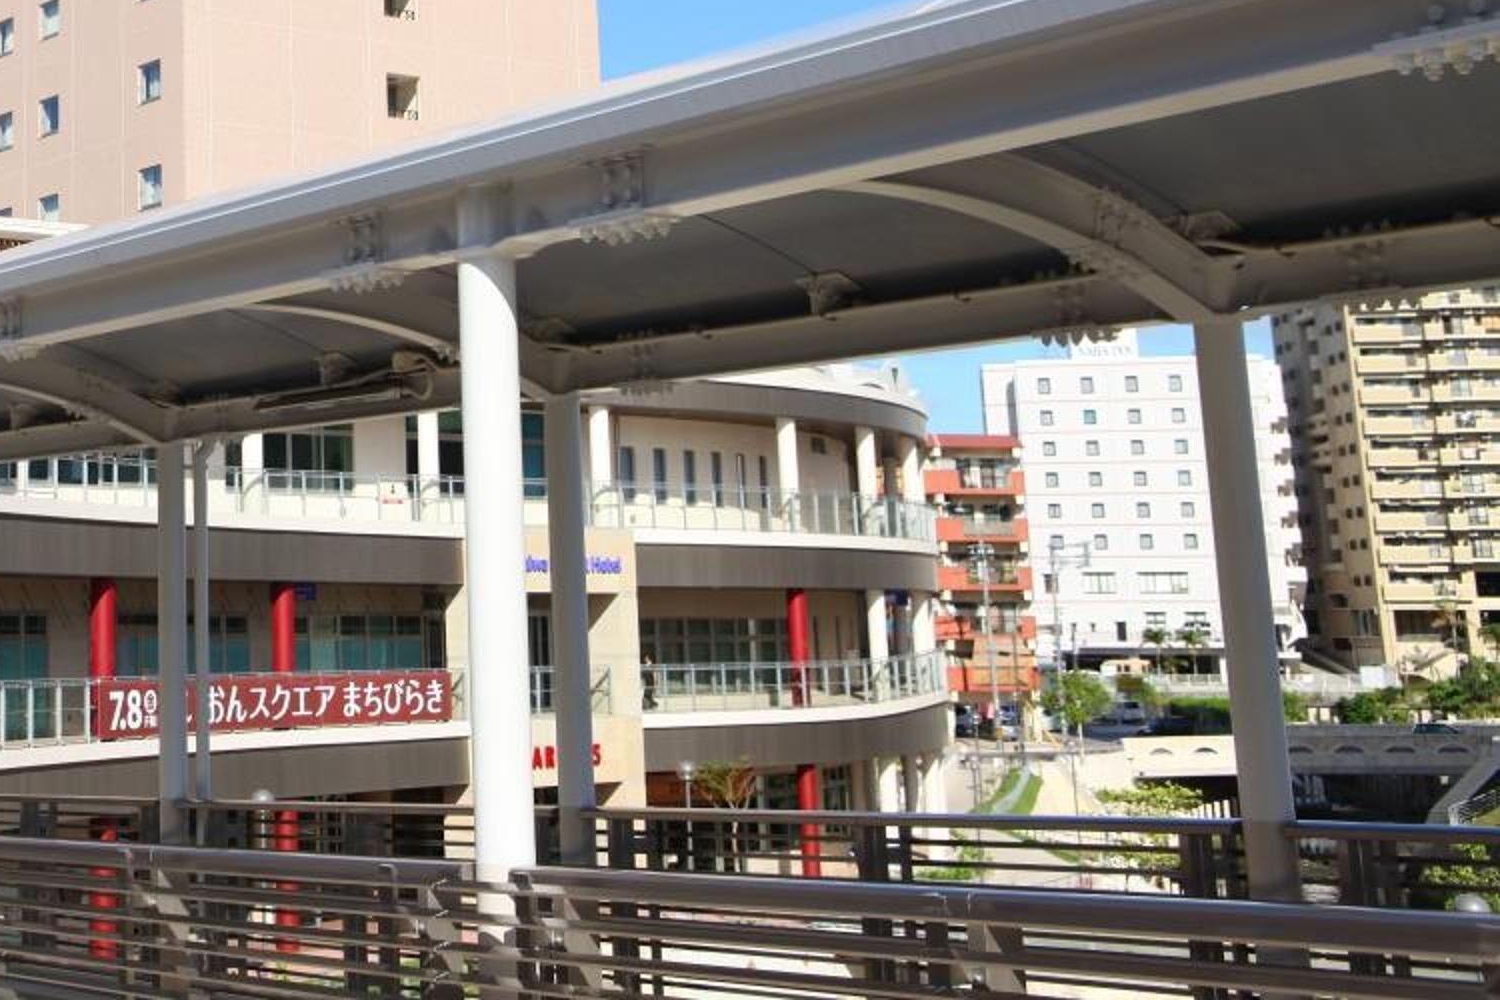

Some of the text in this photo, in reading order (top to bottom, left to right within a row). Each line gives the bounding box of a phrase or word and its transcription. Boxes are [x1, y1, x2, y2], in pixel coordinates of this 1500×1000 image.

[186, 684, 334, 725] おんスクエア
[342, 679, 444, 717] まちびらき
